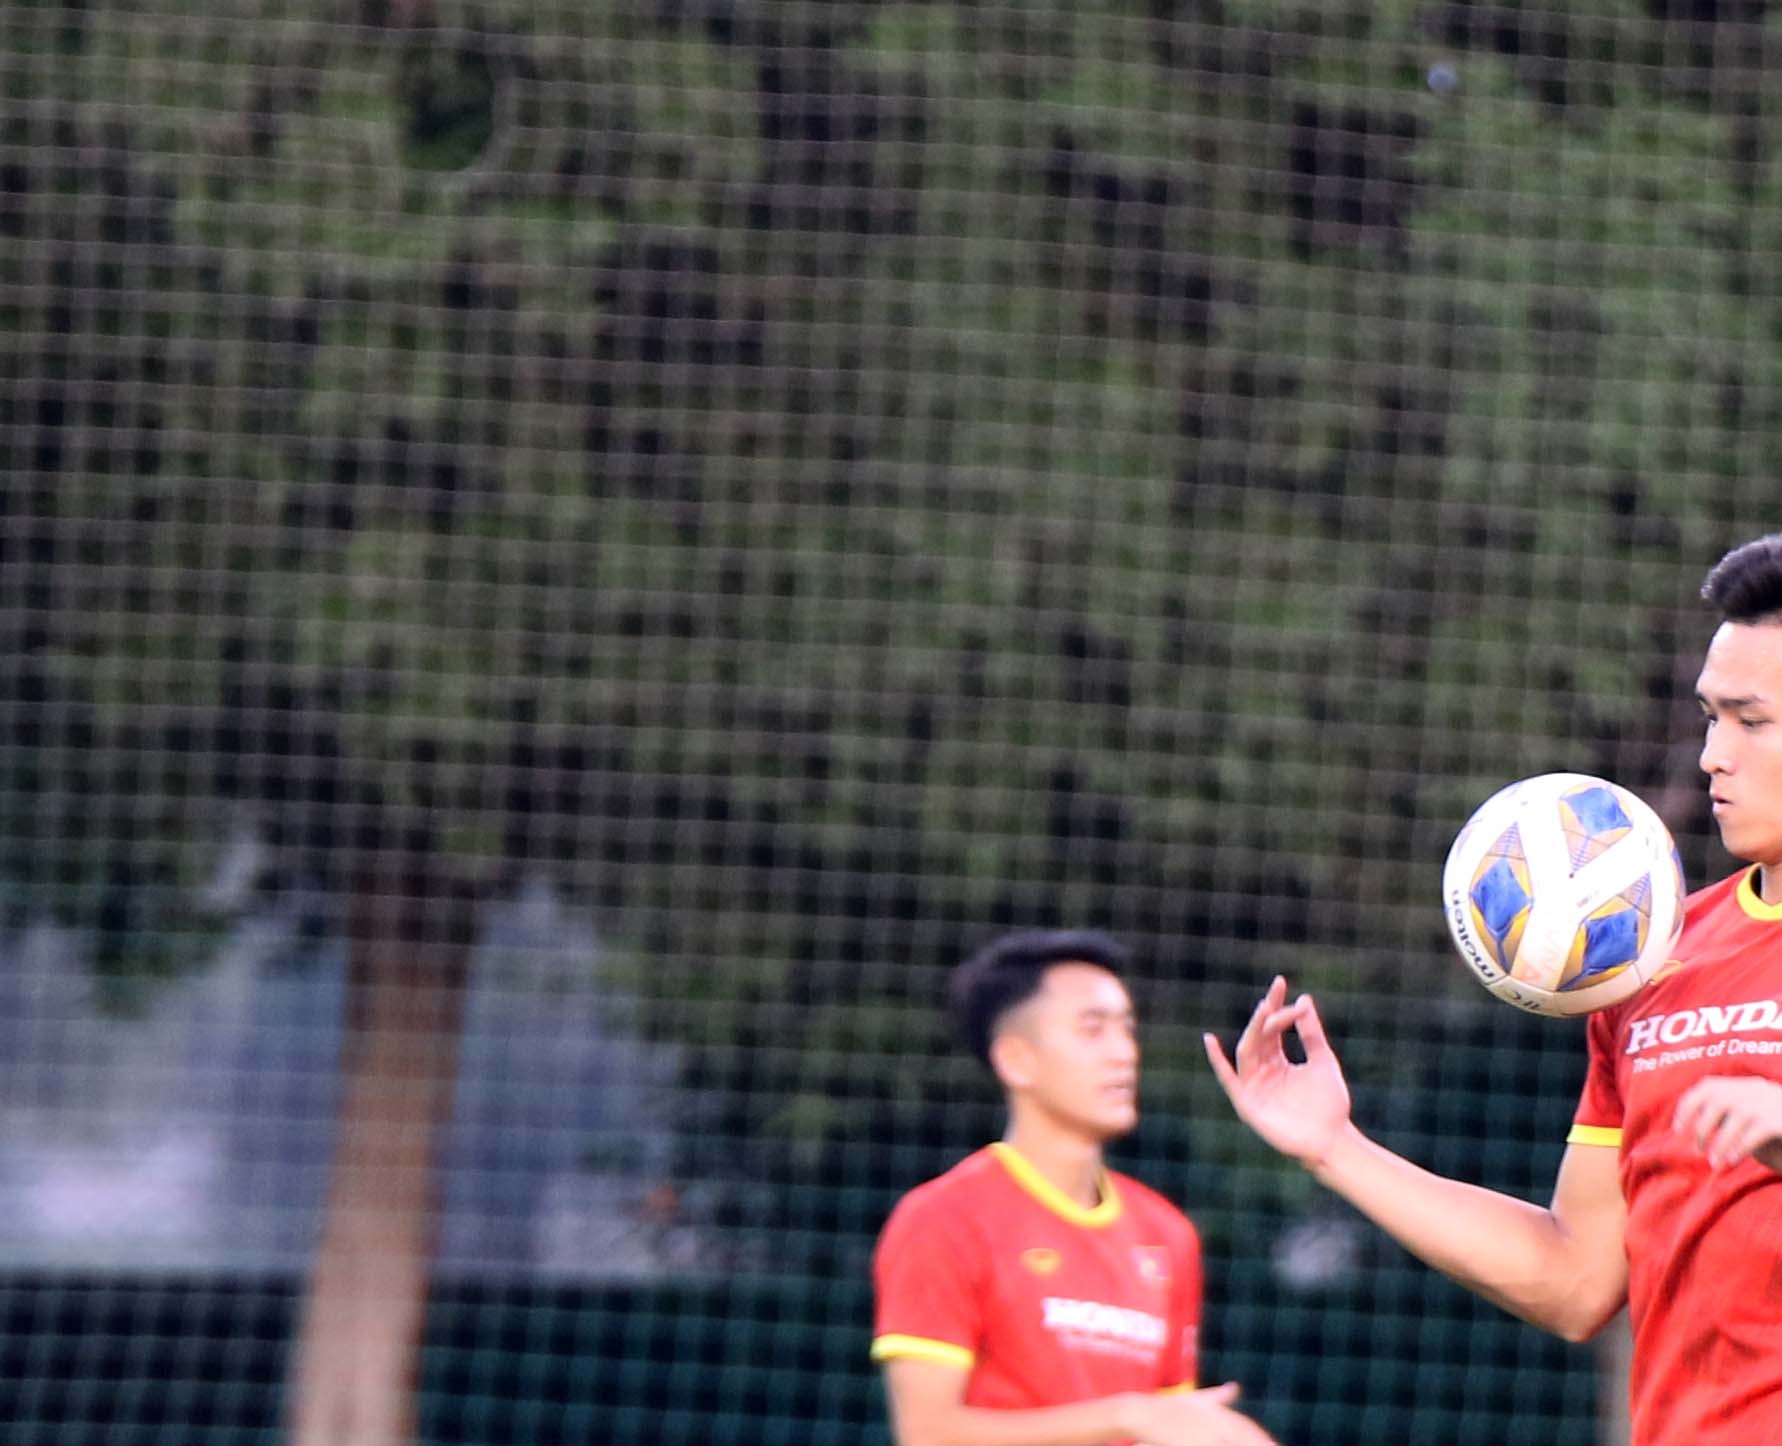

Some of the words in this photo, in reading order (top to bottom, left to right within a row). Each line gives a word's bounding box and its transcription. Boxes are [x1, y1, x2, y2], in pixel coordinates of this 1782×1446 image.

[1633, 1058, 1657, 1073] The
[1660, 1047, 1704, 1065] Power
[1707, 1040, 1726, 1057] of
